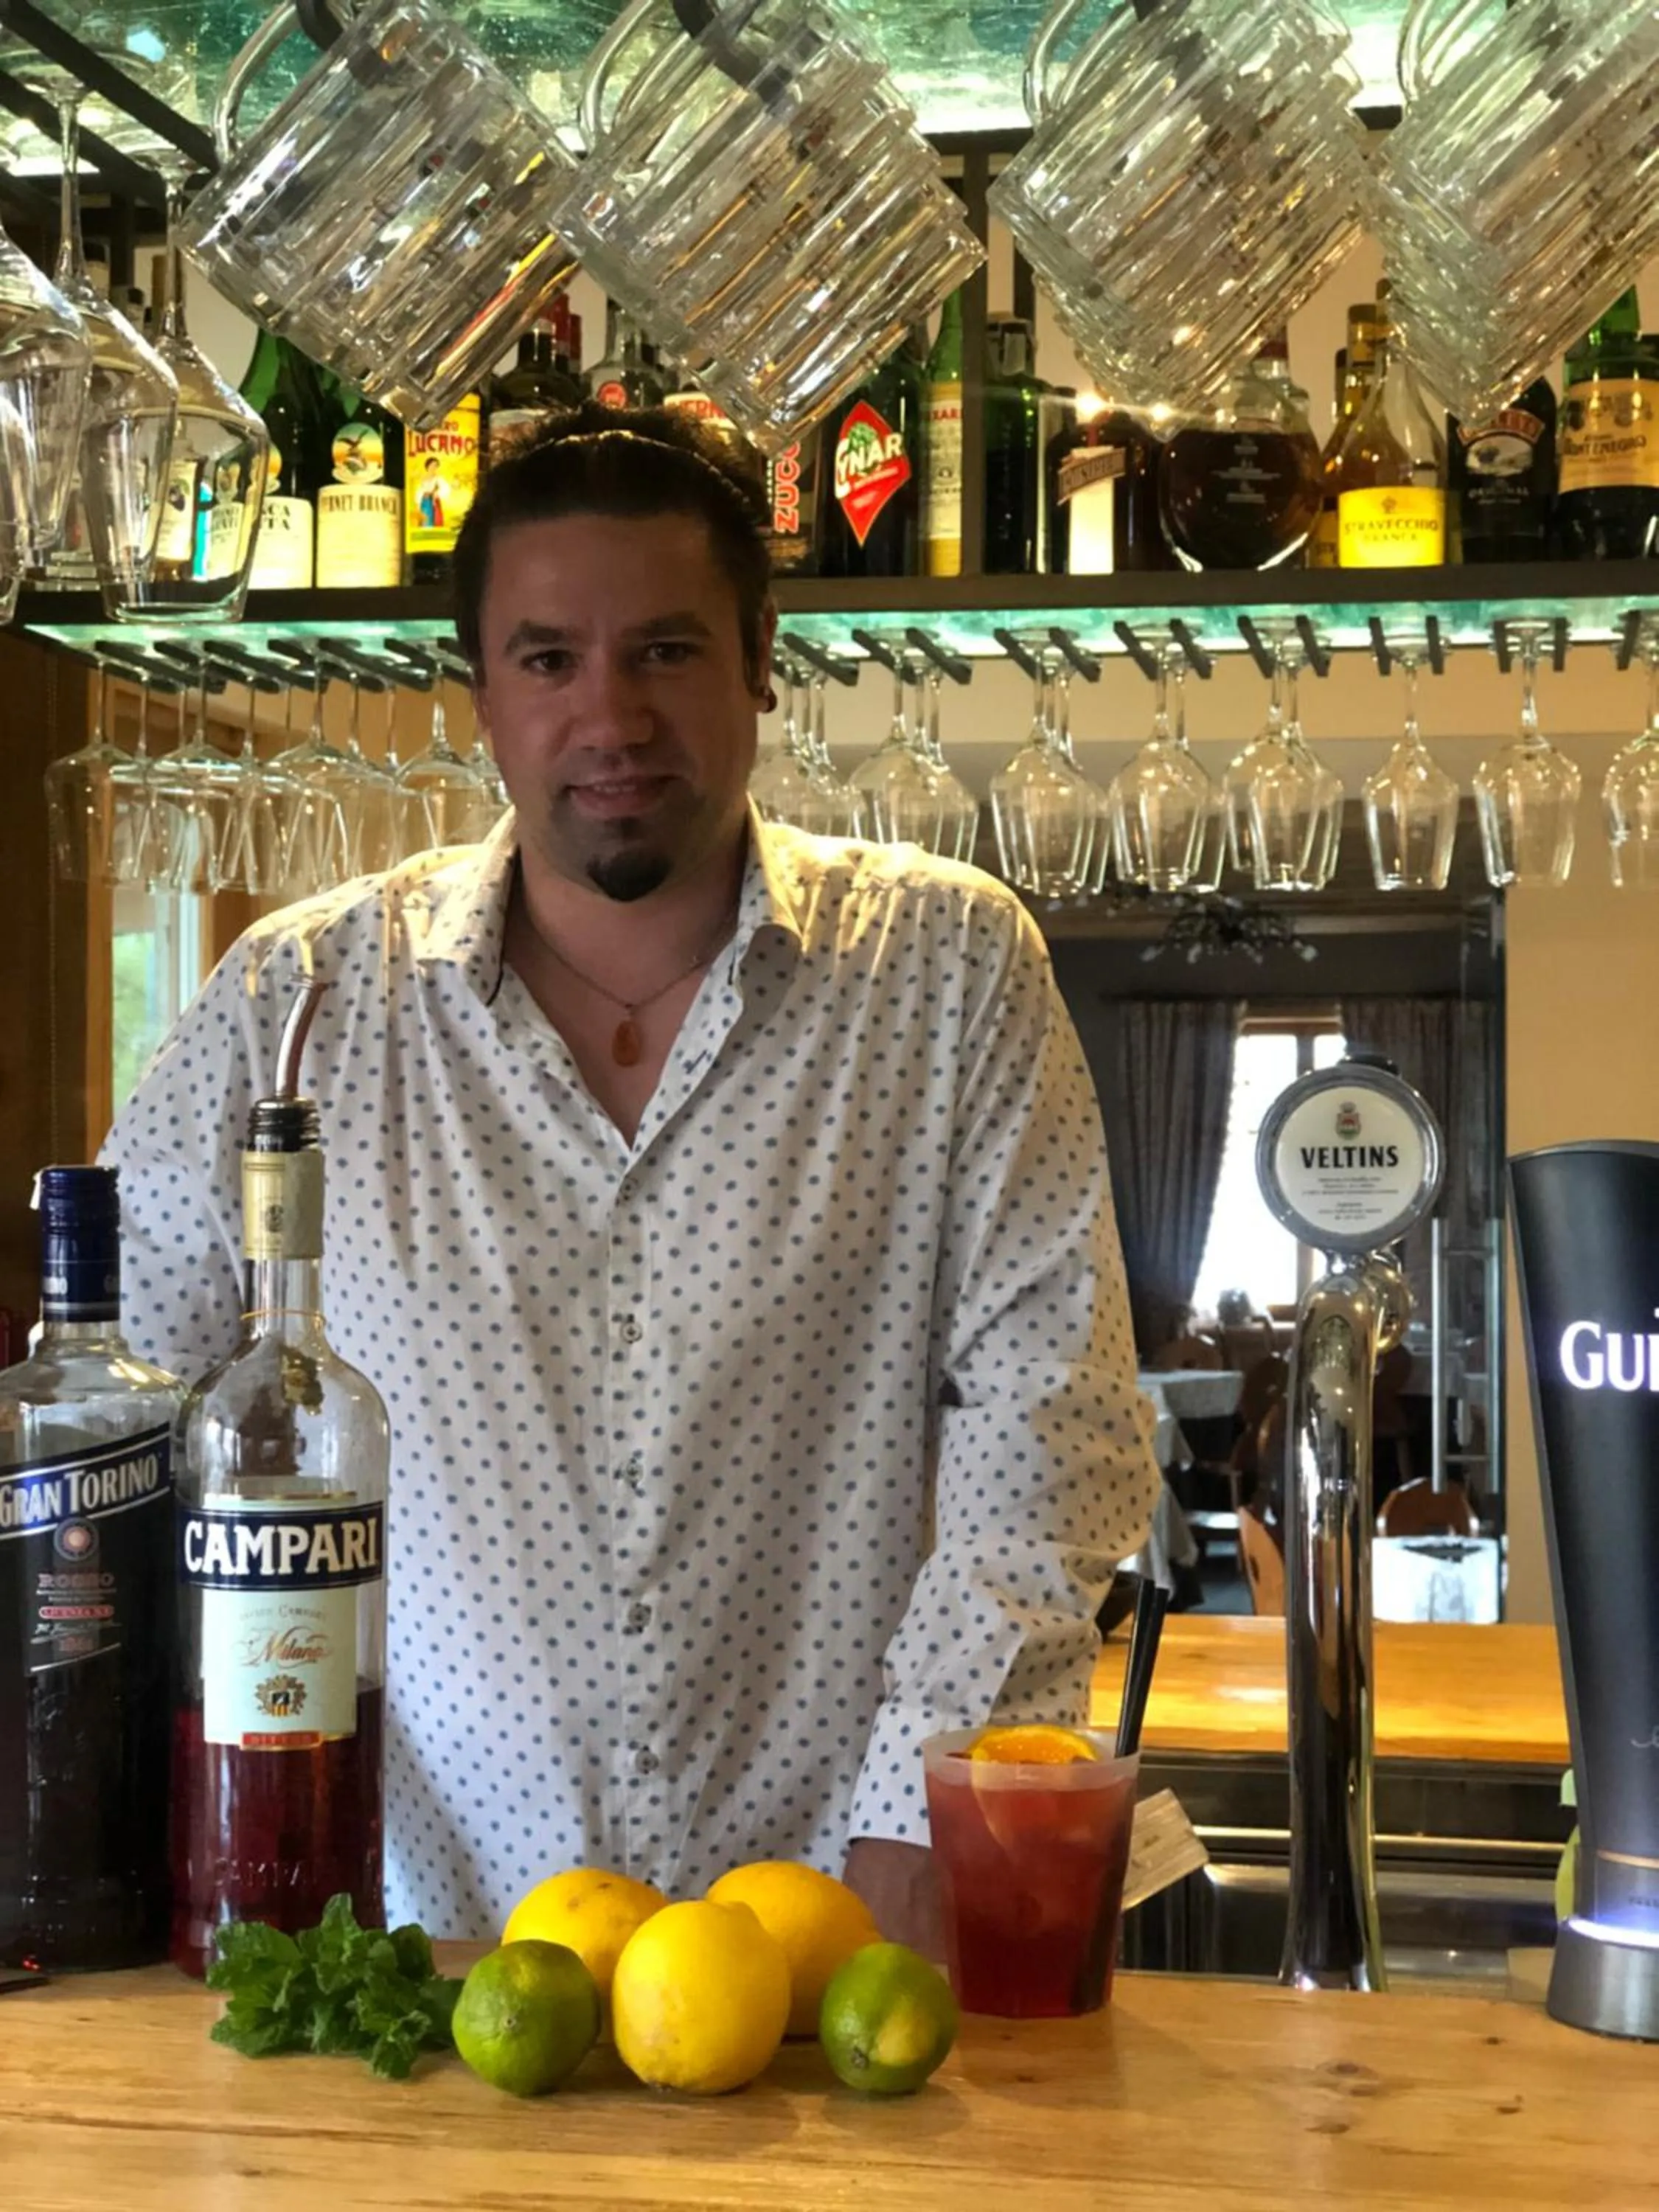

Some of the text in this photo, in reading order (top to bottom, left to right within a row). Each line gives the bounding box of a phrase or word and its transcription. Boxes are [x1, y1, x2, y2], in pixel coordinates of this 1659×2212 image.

[408, 431, 476, 458] LUCANO
[835, 432, 903, 500] CYNAR
[1301, 1145, 1399, 1169] VELTINS
[0, 1453, 159, 1528] GRAN TORINO
[185, 1517, 378, 1576] CAMPARI
